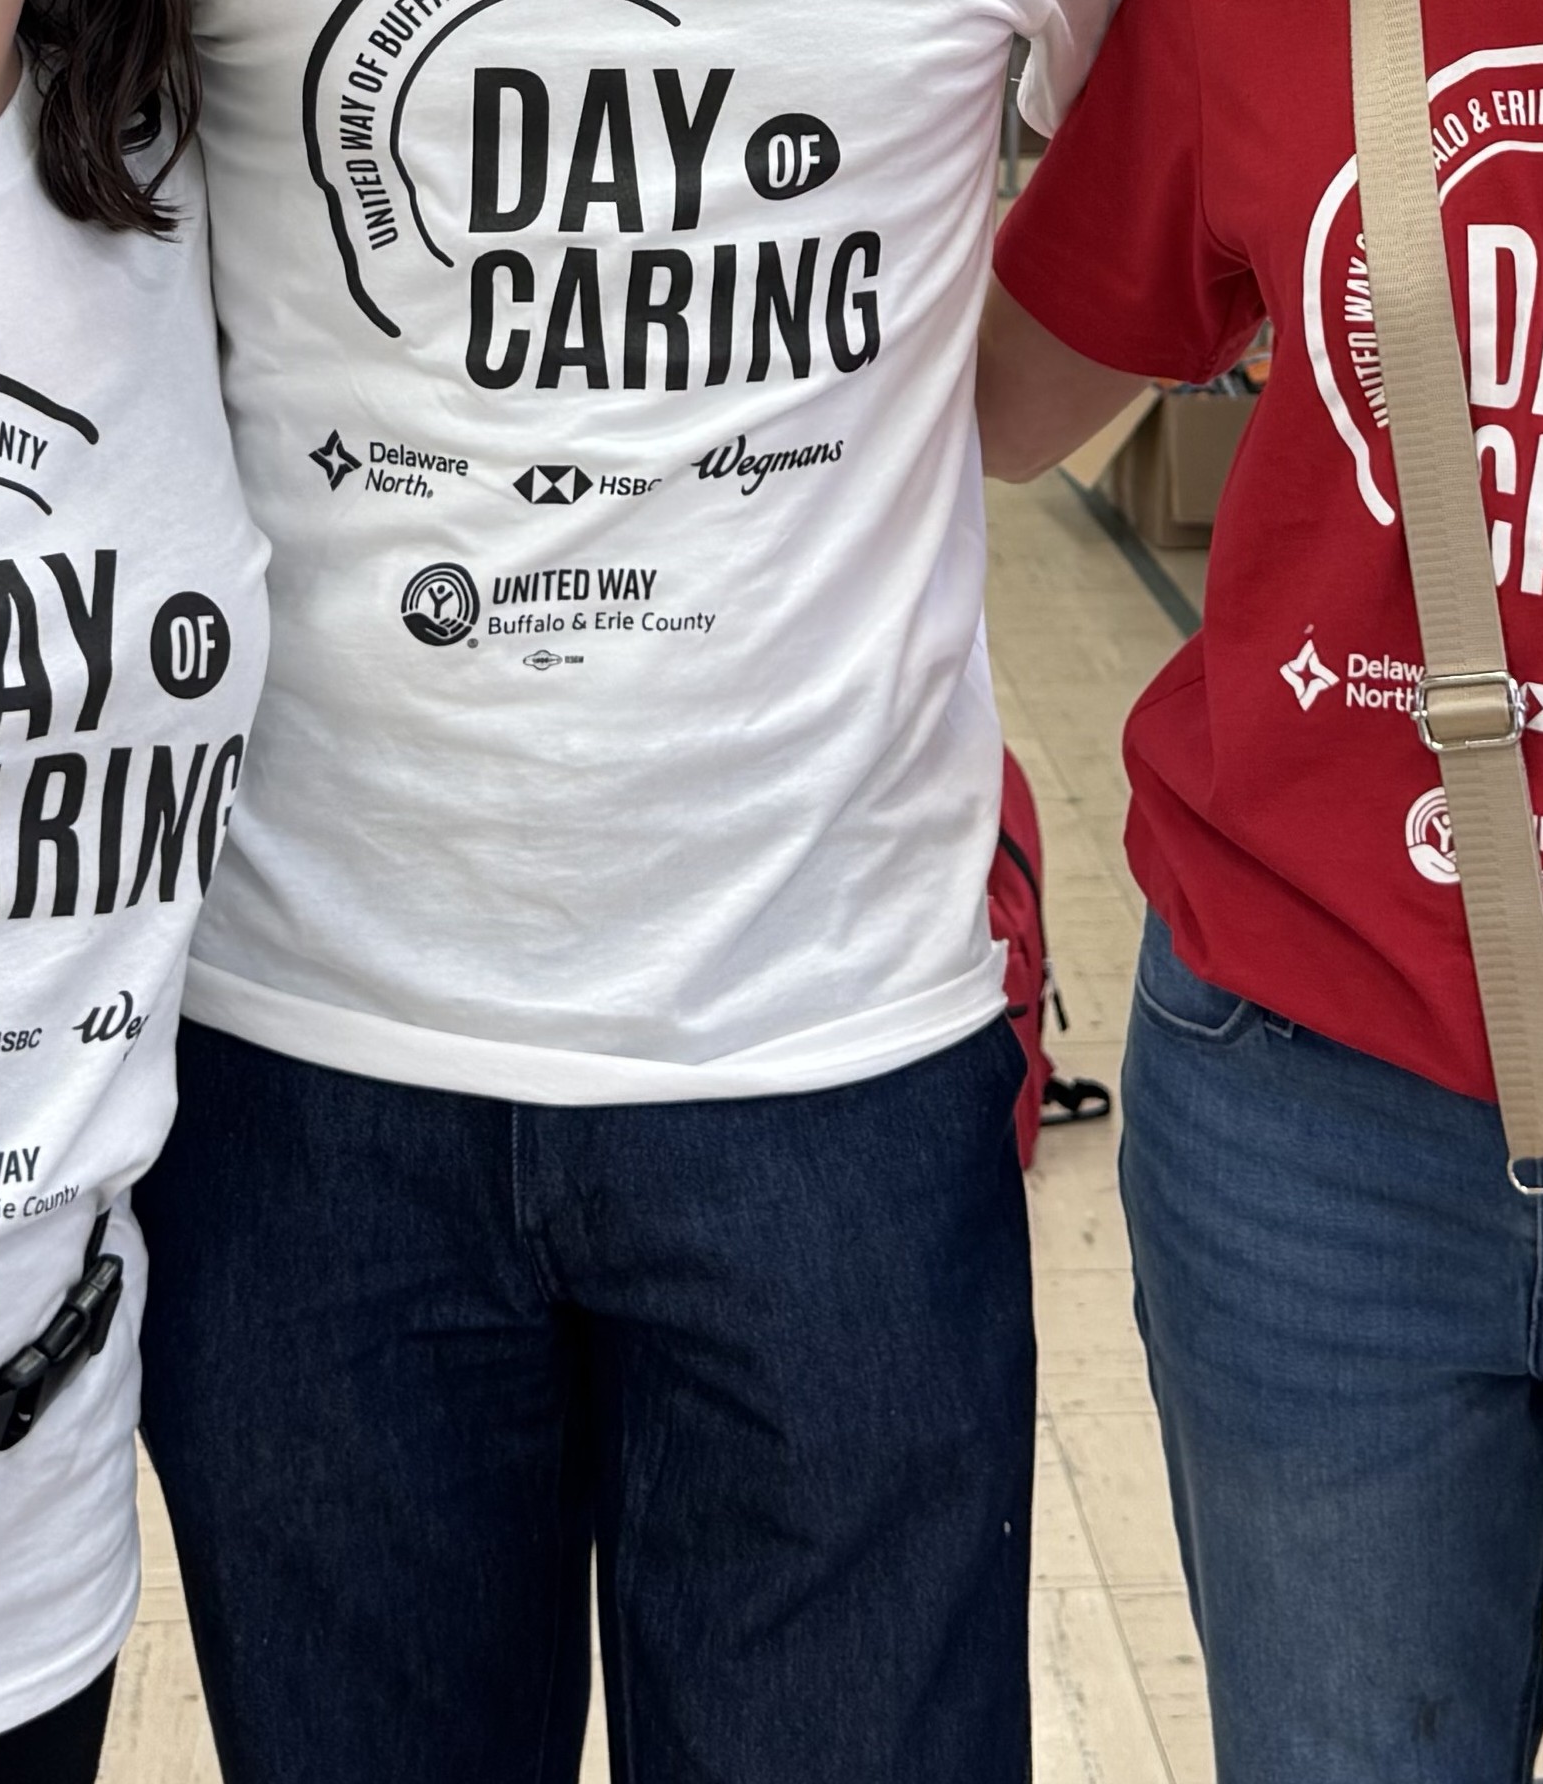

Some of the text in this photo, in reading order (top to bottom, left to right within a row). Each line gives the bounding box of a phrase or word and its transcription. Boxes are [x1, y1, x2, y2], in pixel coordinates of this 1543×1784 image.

[347, 52, 388, 94] OF
[340, 93, 376, 152] WAY
[1467, 98, 1491, 133] &
[468, 67, 821, 233] DAY OF
[345, 158, 399, 251] UNITED
[464, 230, 882, 392] CARING
[369, 441, 468, 476] Delaware
[692, 434, 844, 495] Wegmans
[365, 471, 428, 497] North
[493, 568, 657, 604] UNITED WAY
[487, 610, 716, 635] Buffalo & Erie County
[169, 613, 216, 680] OF
[1347, 653, 1424, 682] Delaw
[22, 1181, 79, 1218] County
